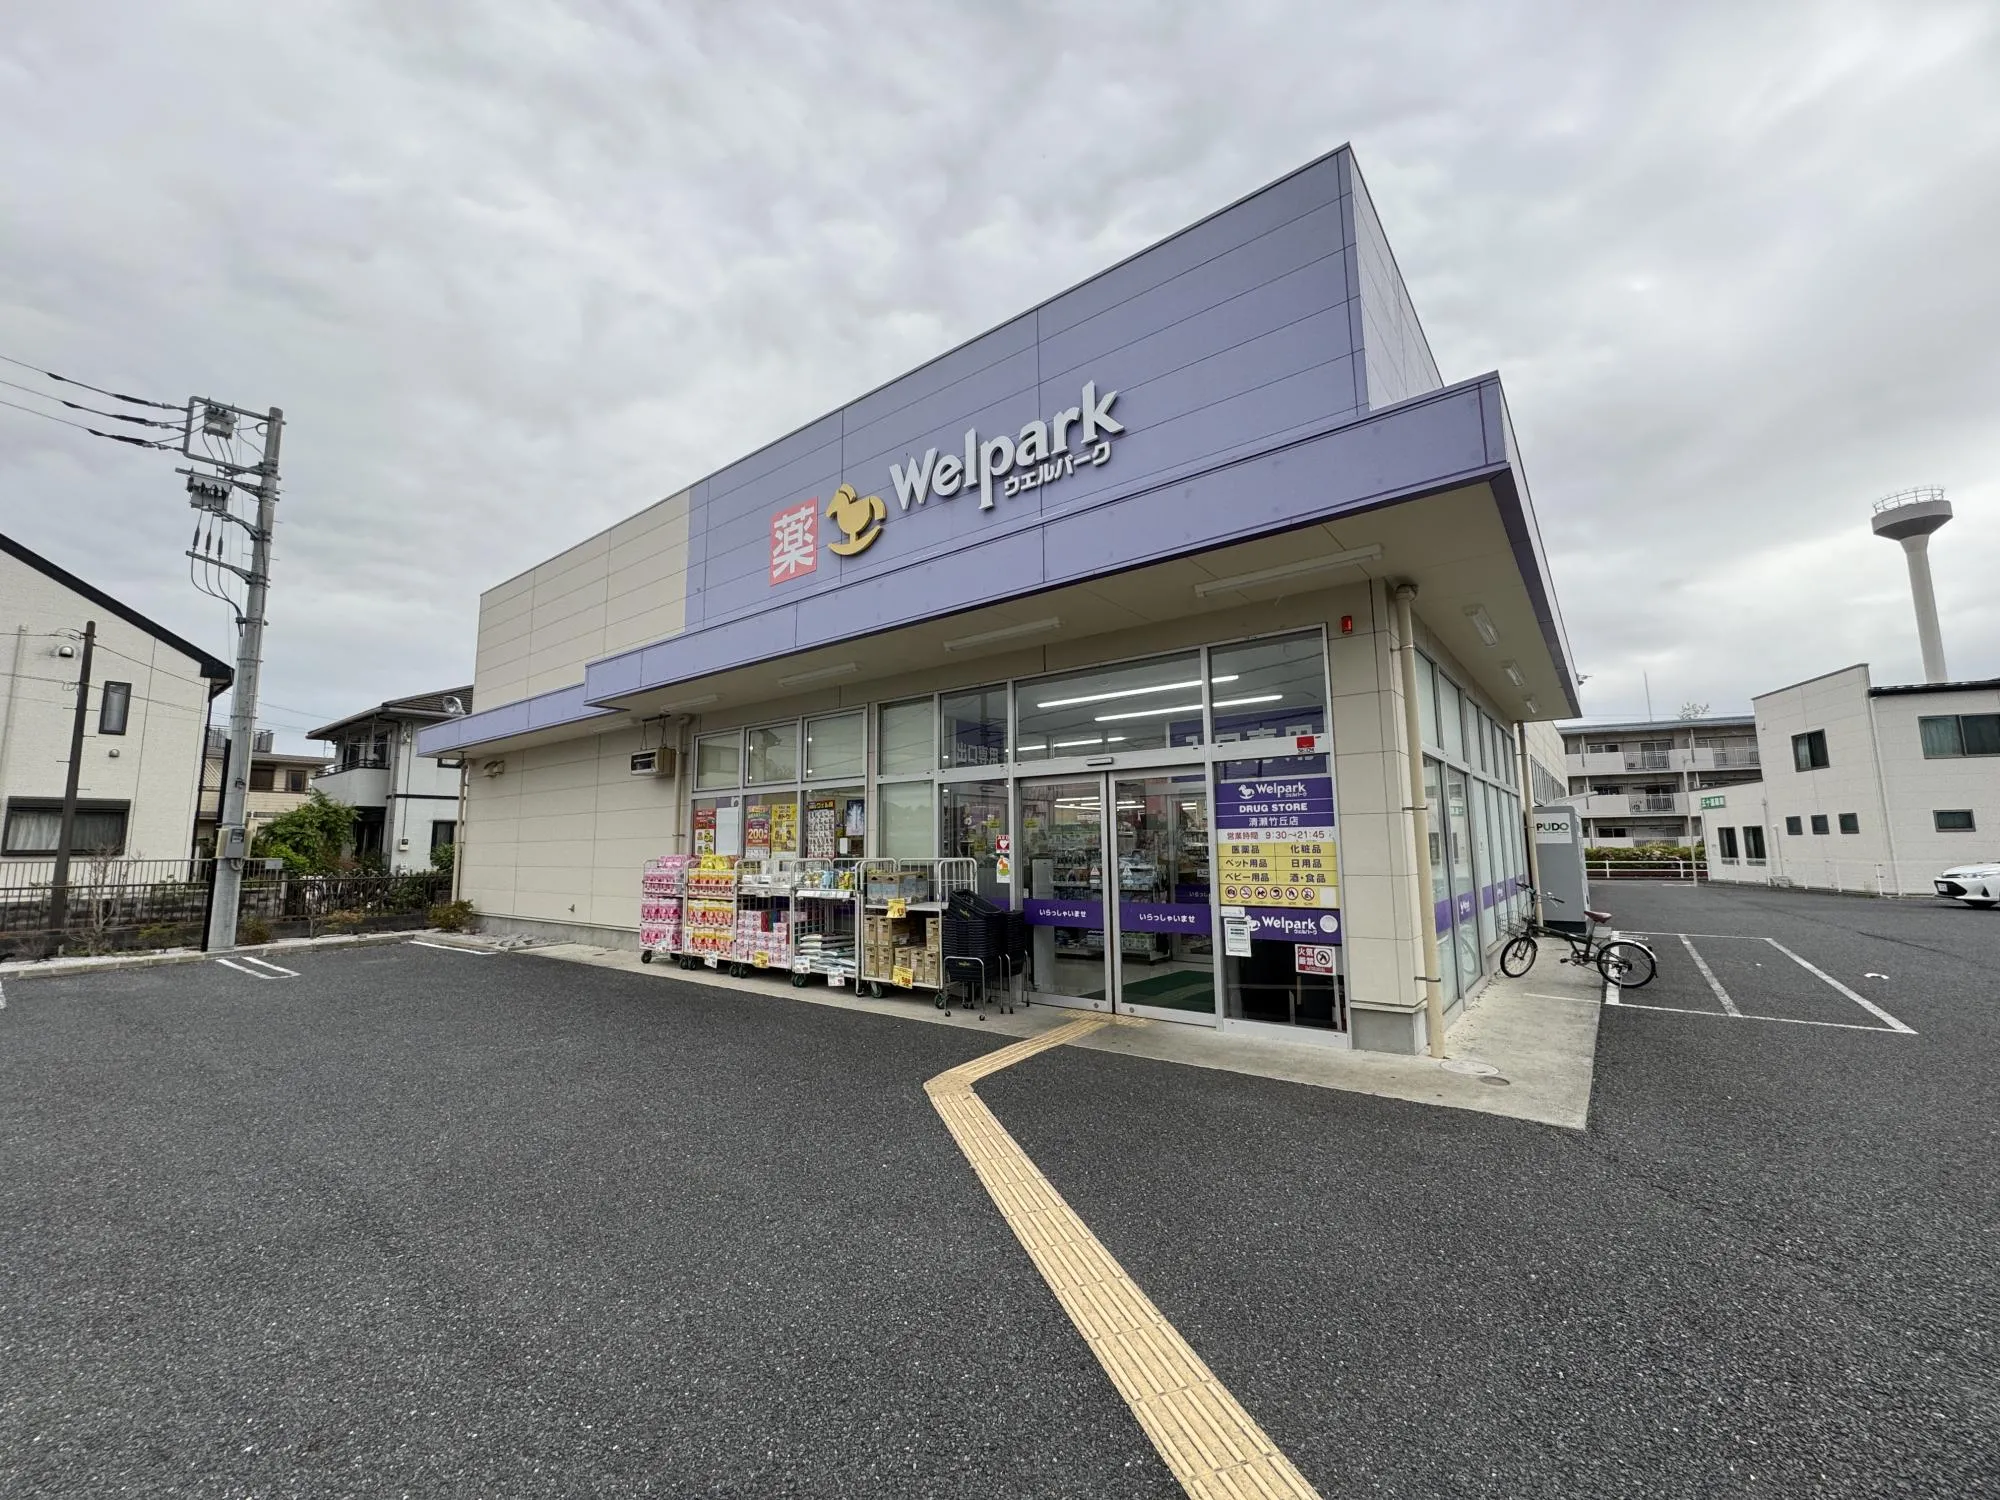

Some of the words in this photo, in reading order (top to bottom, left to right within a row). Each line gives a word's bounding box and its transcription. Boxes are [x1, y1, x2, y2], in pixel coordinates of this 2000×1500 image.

[889, 380, 1125, 510] Welpark
[771, 504, 816, 578] 薬
[1255, 781, 1307, 798] Welpark
[1239, 804, 1269, 813] DRUG
[1271, 803, 1308, 812] STORE
[1249, 816, 1299, 827] 清瀬竹丘店
[1536, 822, 1569, 831] PUDO
[748, 828, 764, 840] 200
[1227, 831, 1259, 840] 営業時間
[1231, 845, 1260, 854] 医薬品
[1290, 844, 1321, 854] 化粧品
[1291, 858, 1322, 868] 日用品
[1225, 873, 1270, 882] ベビー用品
[1039, 908, 1087, 918] いらっしゃいませ
[1139, 913, 1196, 923] いらっしゃいませ
[1261, 915, 1317, 934] Welpark
